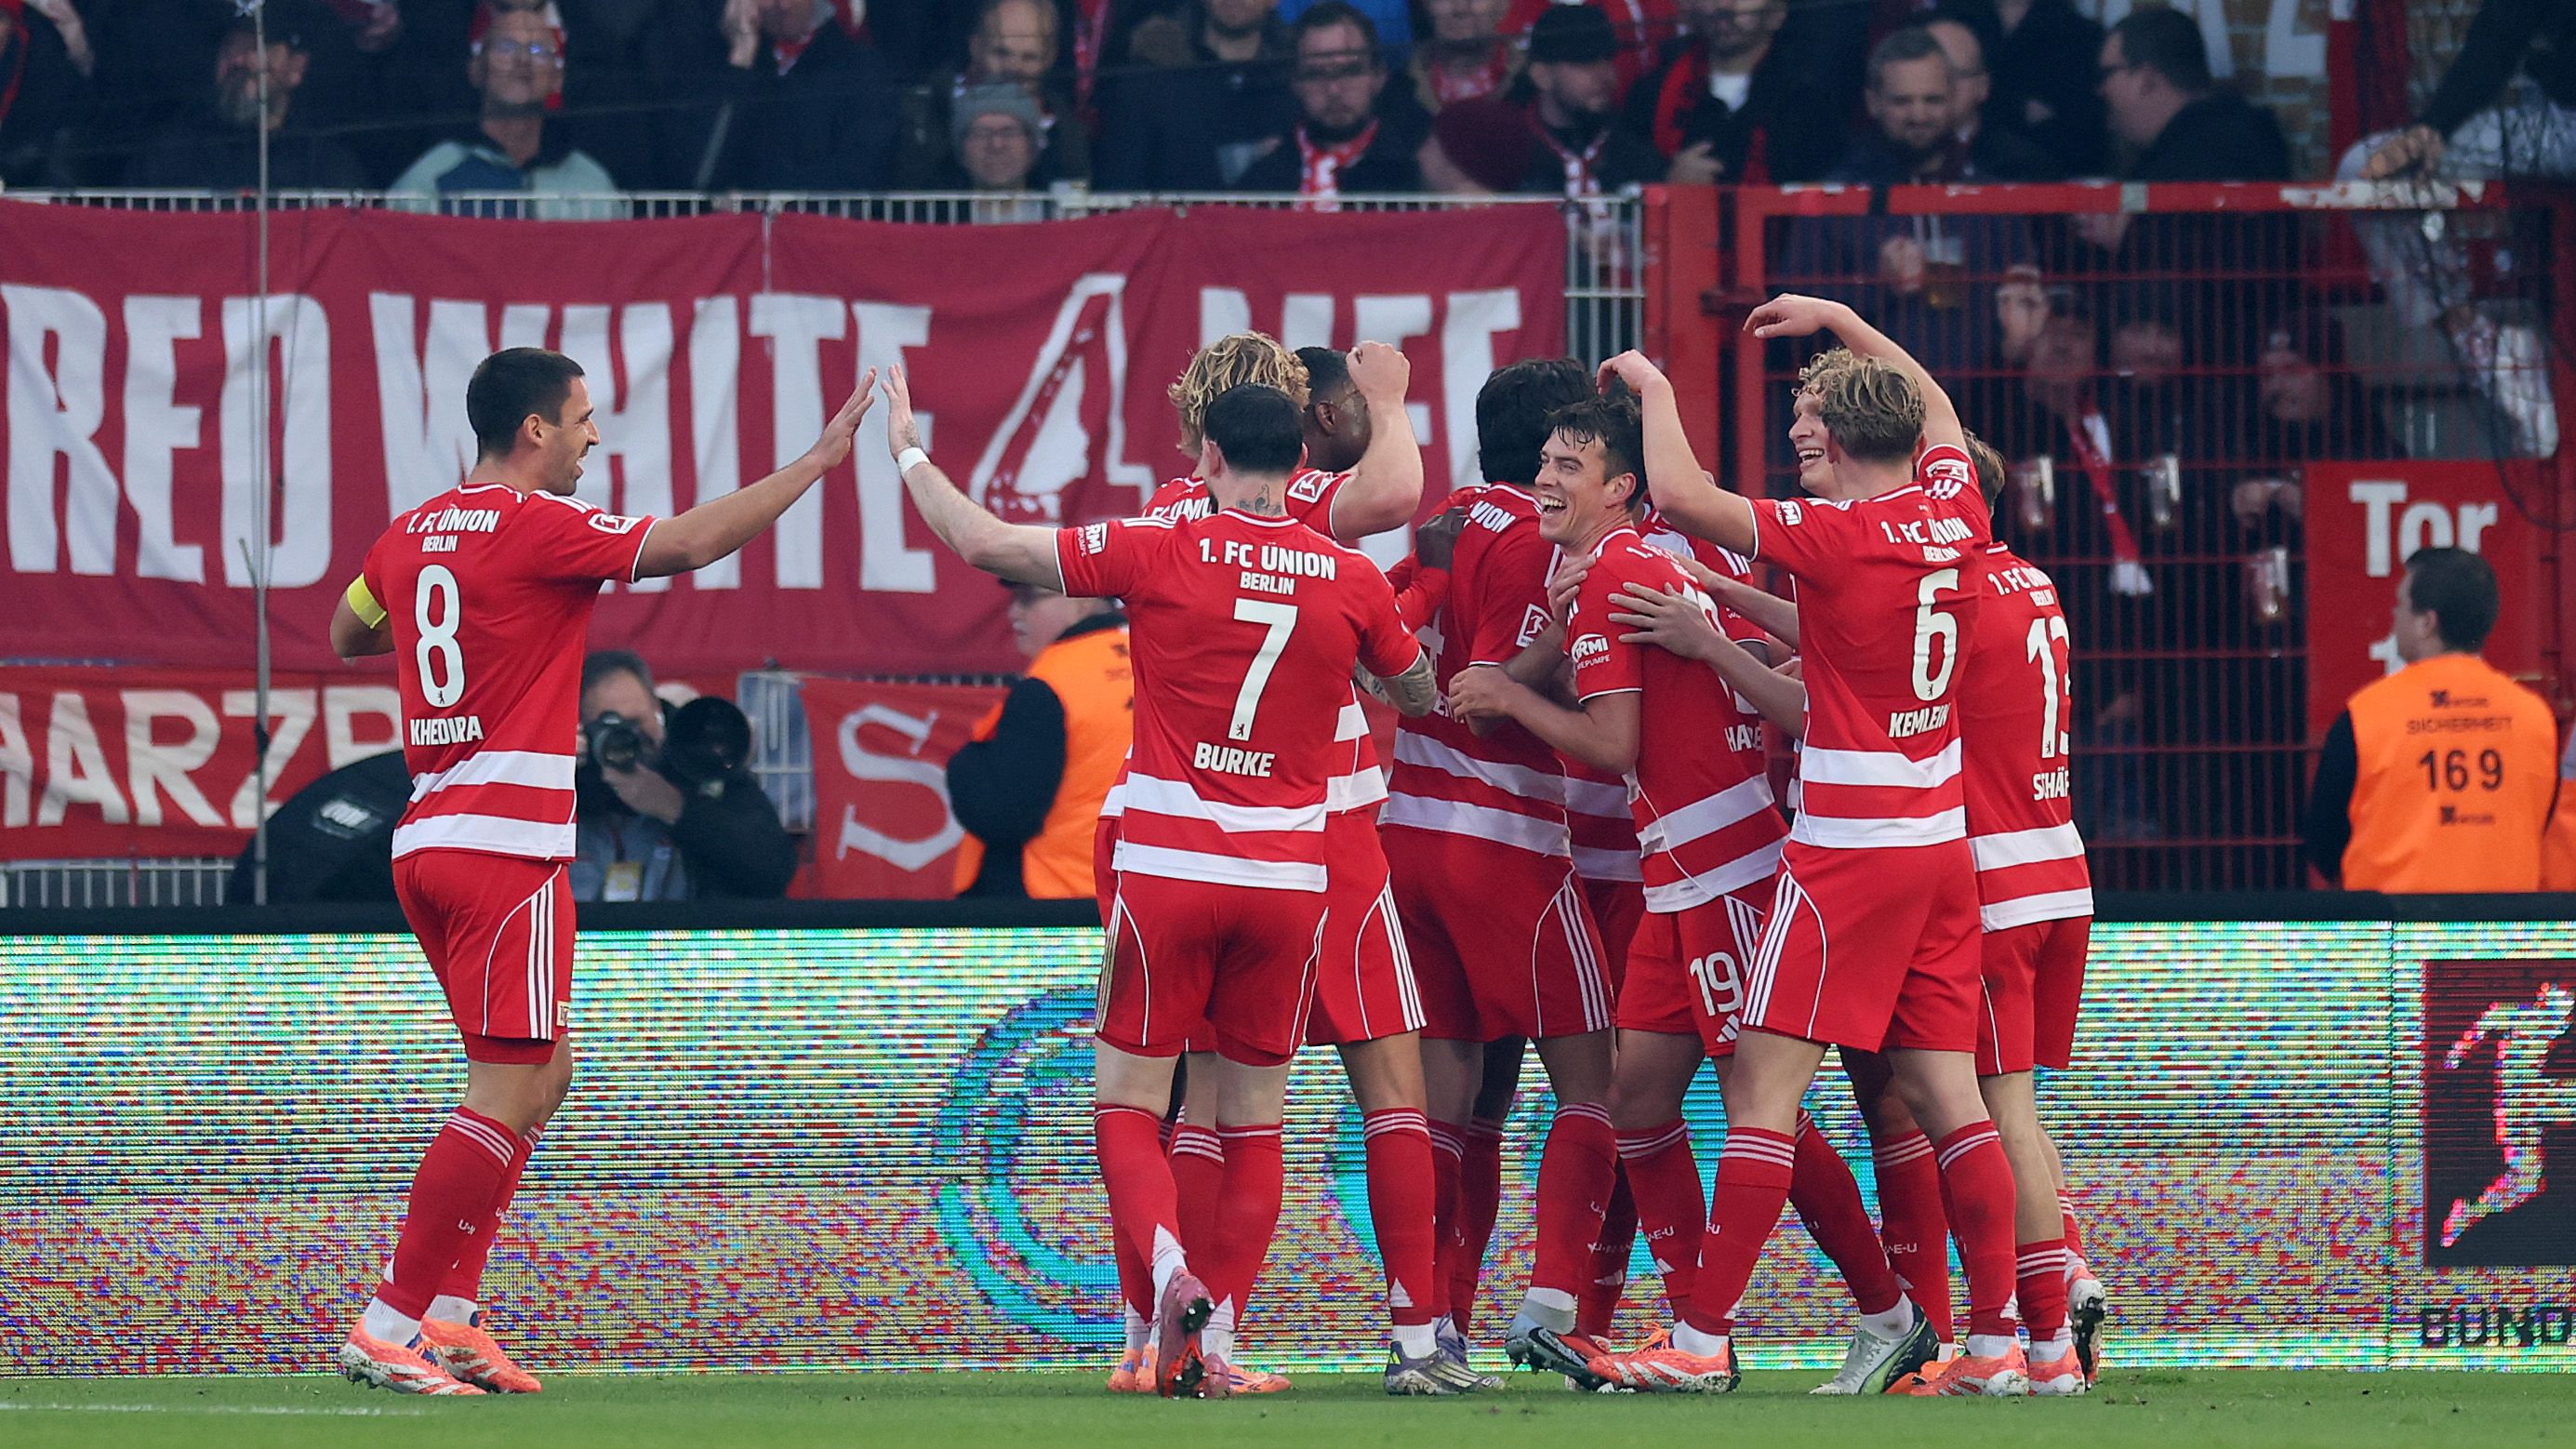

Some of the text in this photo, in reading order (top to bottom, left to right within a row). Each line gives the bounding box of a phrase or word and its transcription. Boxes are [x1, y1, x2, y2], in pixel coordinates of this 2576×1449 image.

[1, 284, 332, 588] RED
[370, 293, 936, 592] WHITE
[437, 508, 501, 533] UNION
[421, 535, 458, 552] BERLIN
[1199, 538, 1336, 581] 1. FC UNION
[1240, 571, 1295, 595] BERLIN
[415, 565, 465, 708] 8
[1912, 568, 1959, 701] 6
[1228, 598, 1298, 741] 7
[409, 715, 484, 746] KHEDIRA
[1888, 702, 1951, 738] KEMLEIN
[1193, 741, 1276, 778] BURKE
[2419, 748, 2503, 791] 169
[1689, 951, 1743, 1017] 19
